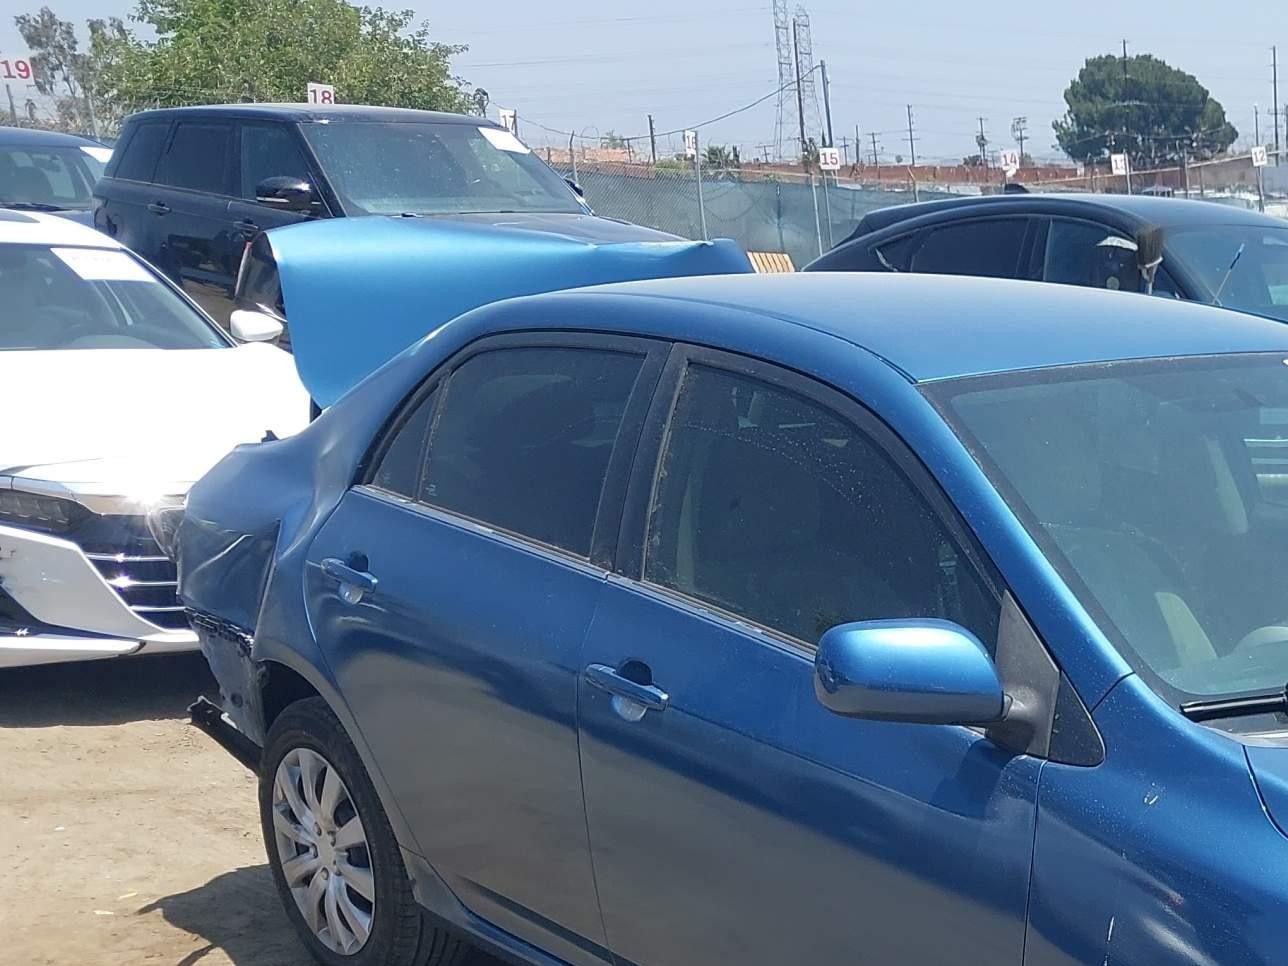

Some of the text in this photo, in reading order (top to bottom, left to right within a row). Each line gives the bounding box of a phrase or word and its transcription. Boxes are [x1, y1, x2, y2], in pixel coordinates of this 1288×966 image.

[0, 60, 31, 80] 19
[309, 88, 333, 105] 18
[821, 152, 839, 166] 15
